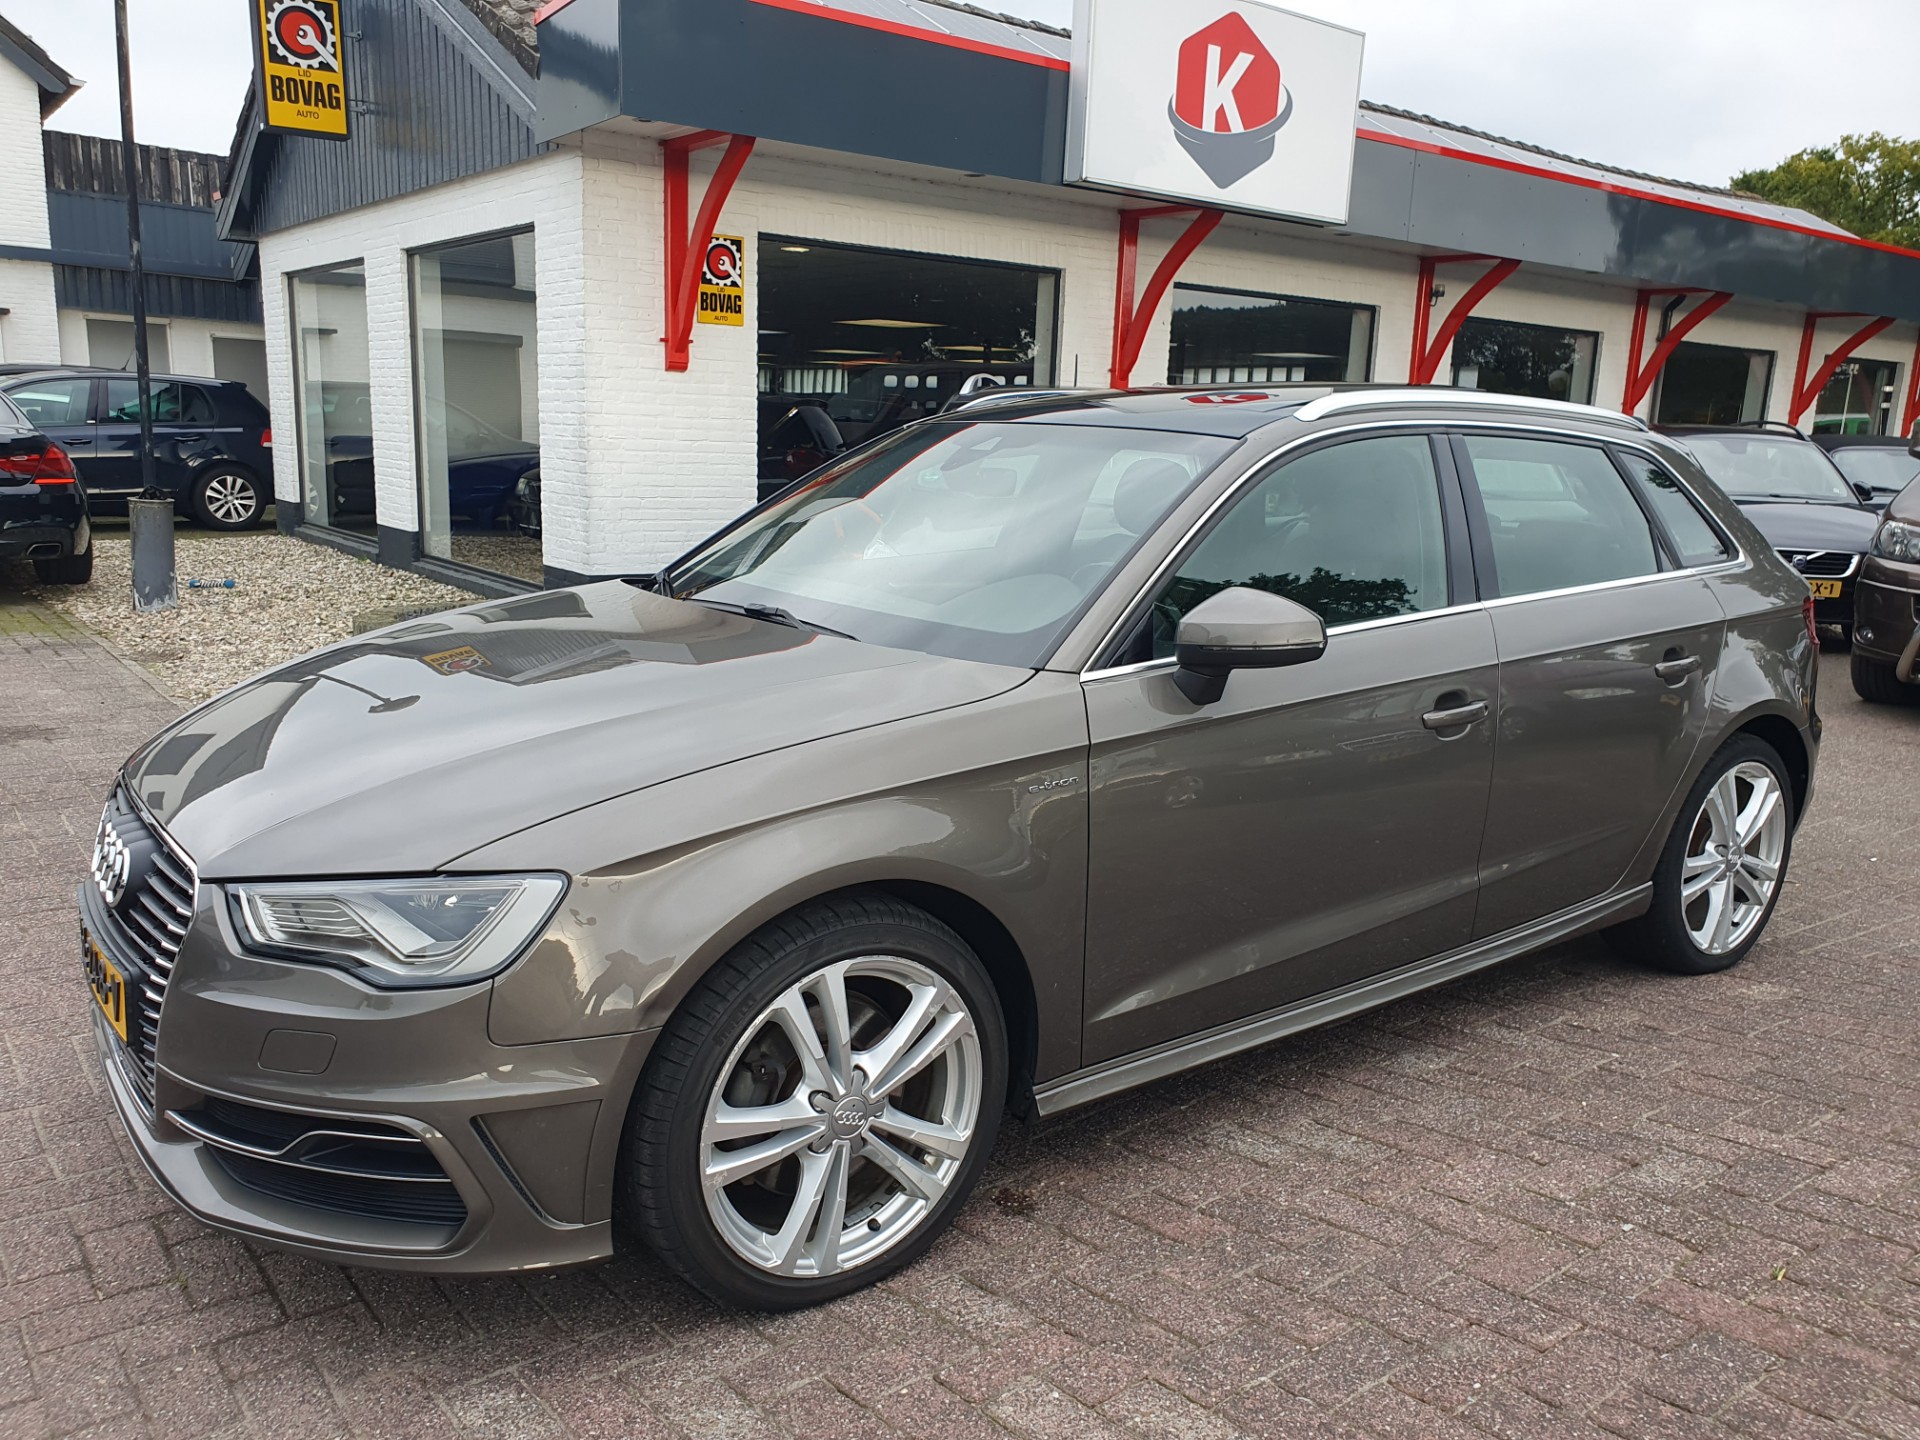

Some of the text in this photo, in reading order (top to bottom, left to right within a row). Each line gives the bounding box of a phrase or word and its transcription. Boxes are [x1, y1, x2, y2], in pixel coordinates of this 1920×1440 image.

[297, 68, 312, 78] LID
[270, 74, 341, 111] BOVAG
[1202, 43, 1255, 133] K
[296, 109, 320, 119] AUTO
[700, 291, 742, 314] BOVAG
